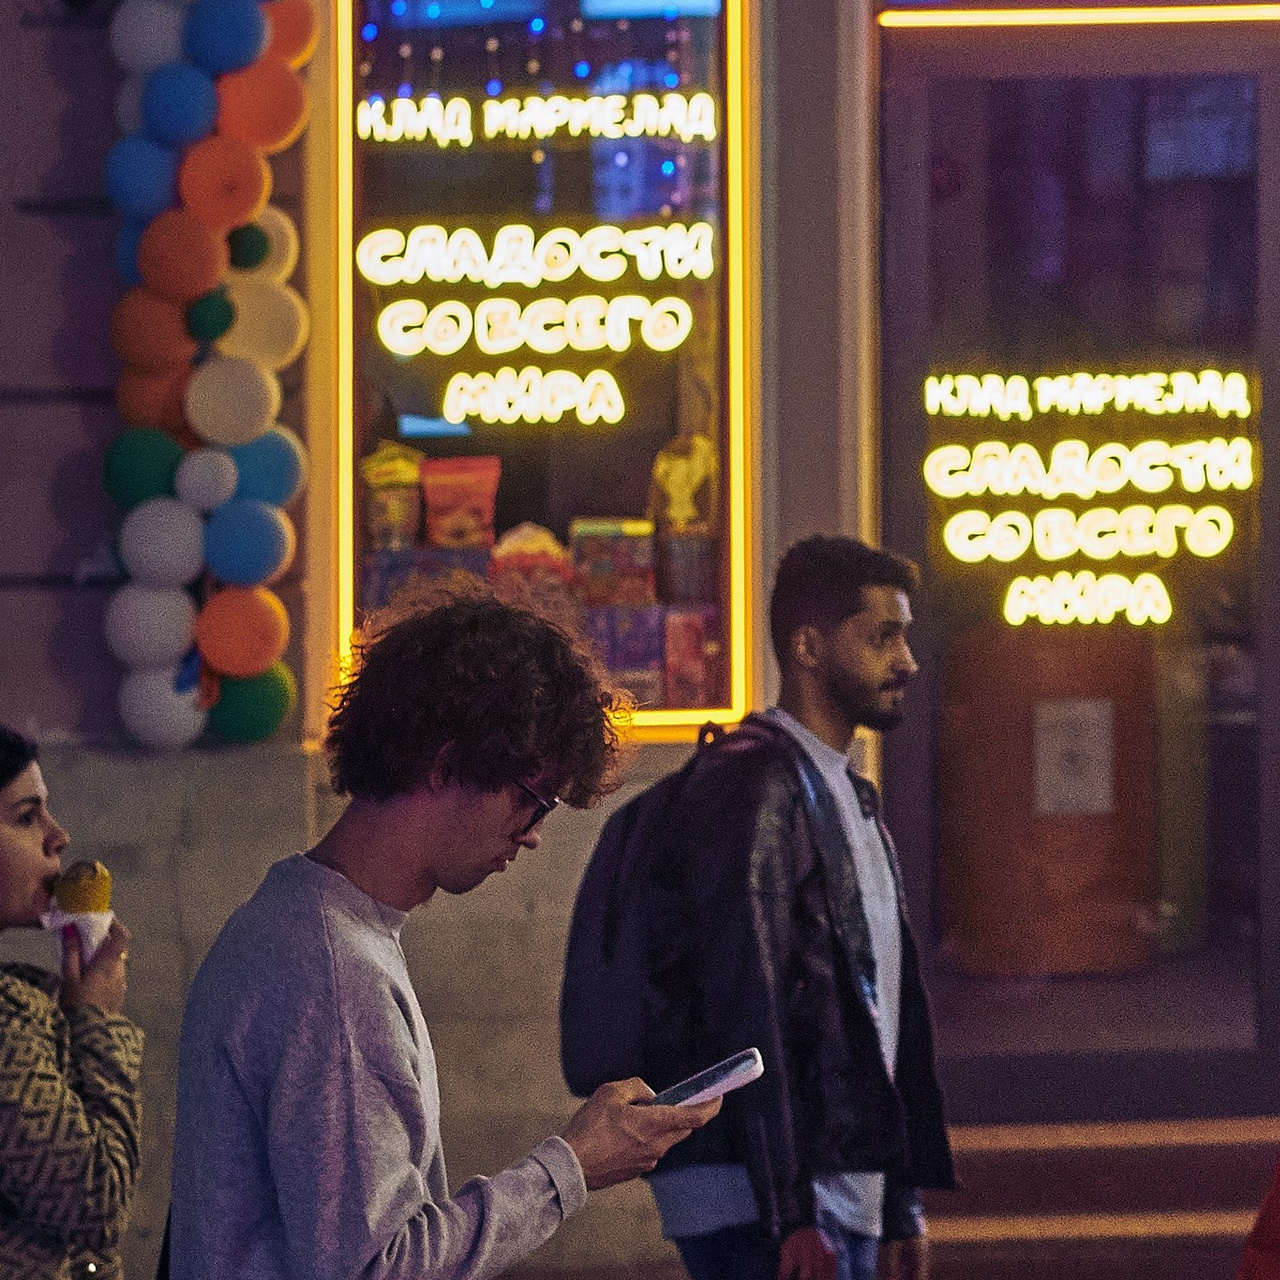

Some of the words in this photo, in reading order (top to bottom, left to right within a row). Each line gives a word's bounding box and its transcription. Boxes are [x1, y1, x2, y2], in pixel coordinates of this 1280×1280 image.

[356, 222, 714, 288] СЛАДОСТИ
[443, 365, 625, 425] МИРА
[923, 436, 1253, 500] СЛАДОСТИ
[1003, 570, 1172, 625] МИРА
